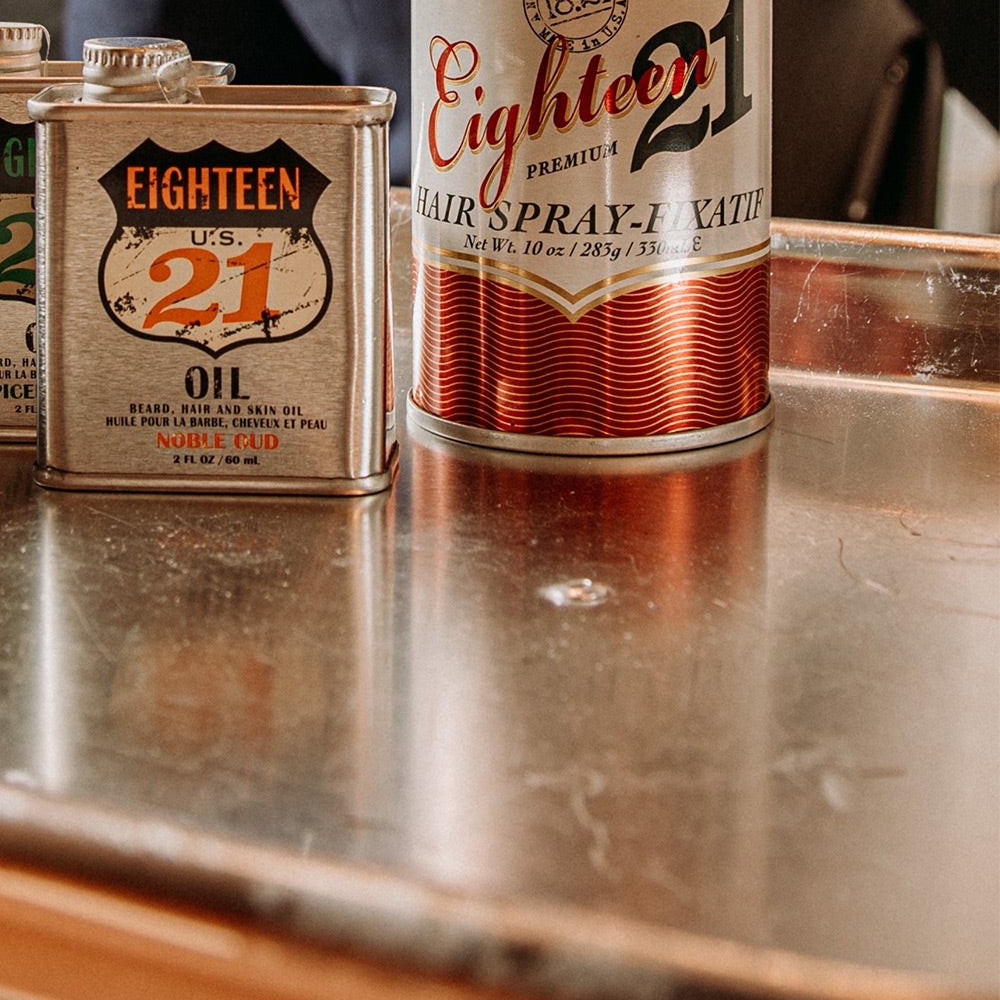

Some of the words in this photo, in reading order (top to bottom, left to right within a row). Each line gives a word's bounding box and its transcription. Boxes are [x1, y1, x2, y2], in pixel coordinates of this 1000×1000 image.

[428, 34, 717, 213] Eighteen
[526, 140, 620, 180] PREMIUM
[127, 166, 300, 210] EIGHTEEN
[416, 185, 476, 228] HAIR
[191, 231, 243, 246] U.S.
[464, 234, 488, 250] Net
[492, 237, 516, 254] Wt.
[523, 240, 543, 255] 10
[546, 247, 565, 257] oz
[580, 241, 622, 261] 283g
[142, 242, 280, 329] 21
[15, 370, 26, 379] LA
[185, 366, 250, 399] OIL
[15, 405, 21, 413] 2
[130, 403, 175, 415] BEARD,
[181, 404, 211, 415] HAIR
[217, 405, 241, 415] AND
[247, 405, 276, 416] SKIN
[283, 406, 304, 416] OIL
[106, 416, 137, 427] HUILE
[141, 417, 169, 427] POUR
[173, 417, 186, 427] LA
[190, 417, 228, 429] BARBE,
[232, 418, 280, 429] CHEVEUX
[284, 419, 296, 429] ET
[300, 419, 328, 430] PEAU
[156, 432, 226, 450] NOBLE
[233, 433, 279, 450] OUD
[173, 455, 180, 464] 2
[184, 455, 197, 465] FL
[200, 455, 215, 465] OZ
[225, 455, 240, 465] 60
[243, 455, 260, 465] mL
